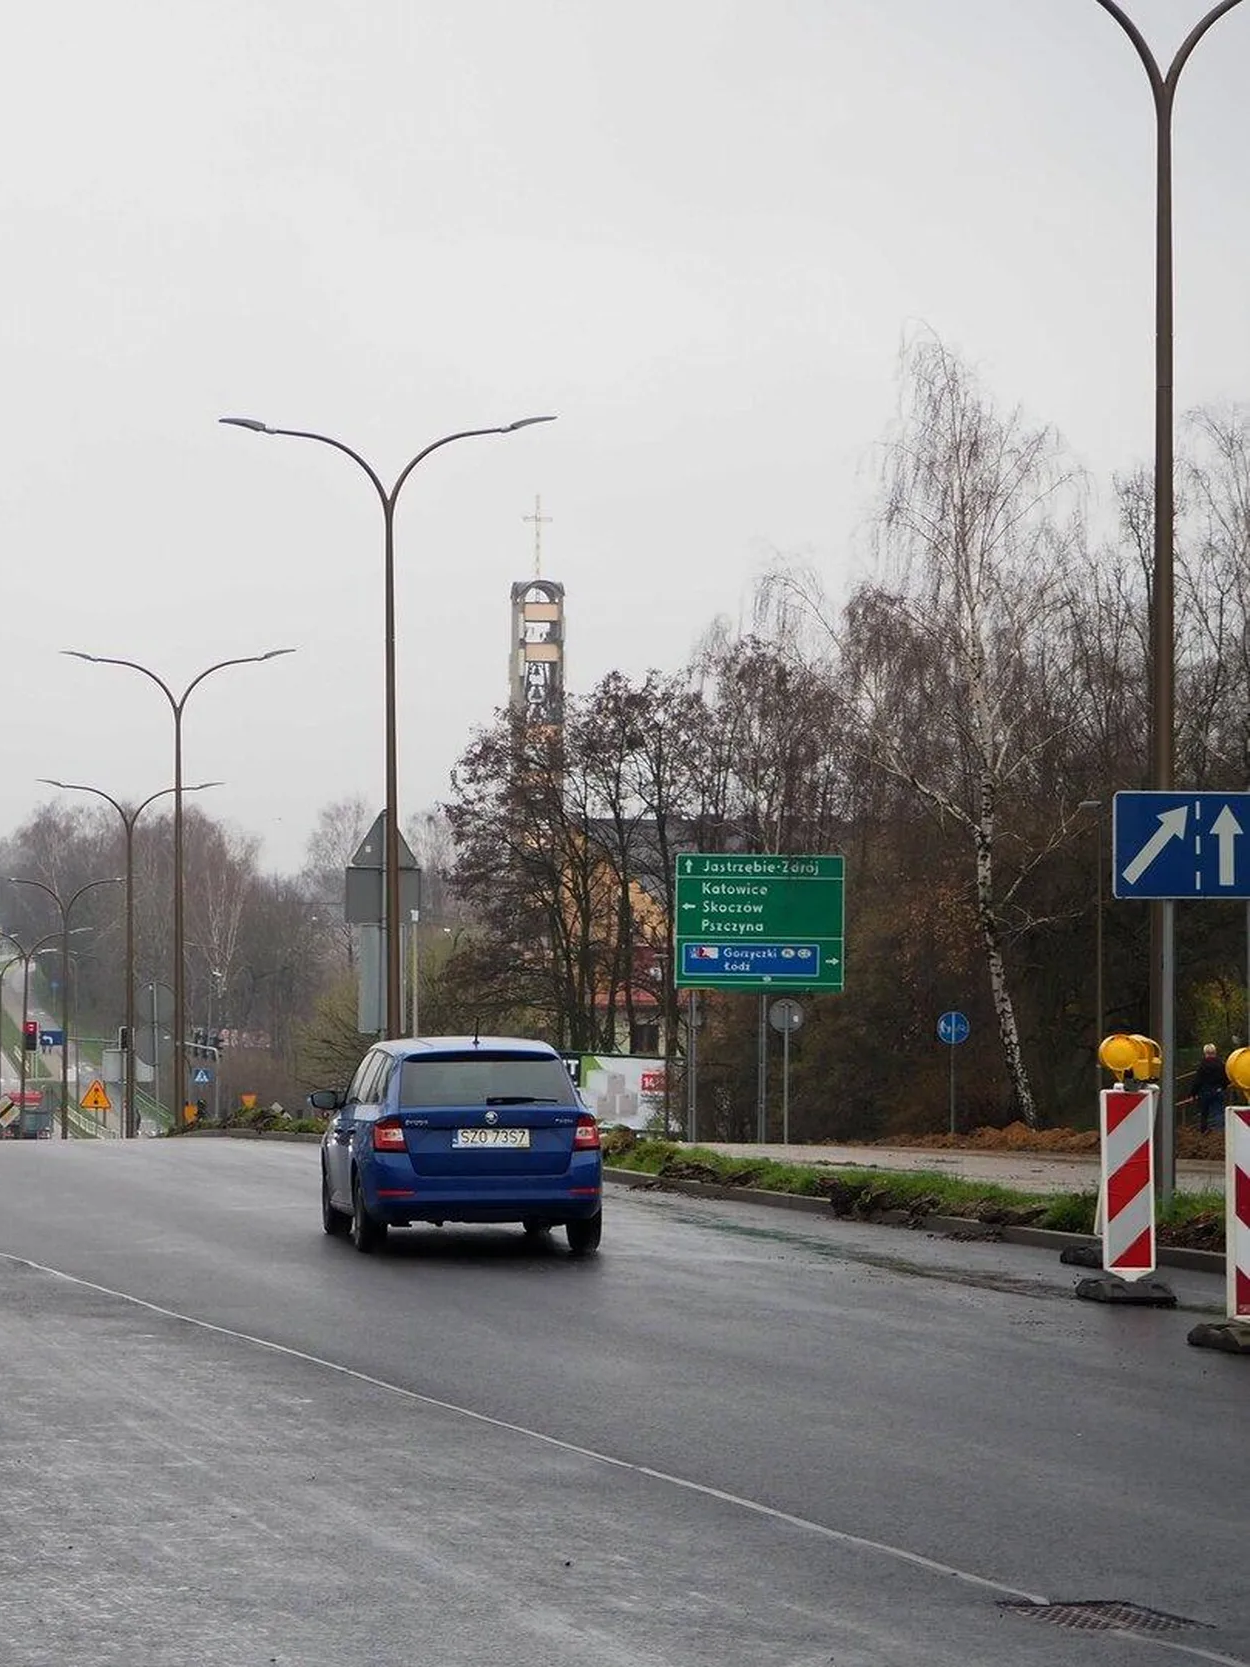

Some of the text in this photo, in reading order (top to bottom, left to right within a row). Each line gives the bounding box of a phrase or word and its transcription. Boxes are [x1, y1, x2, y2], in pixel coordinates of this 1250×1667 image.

[701, 882, 768, 895] Katowice
[702, 900, 764, 913] Skoczów
[701, 919, 764, 934] Pszczyna
